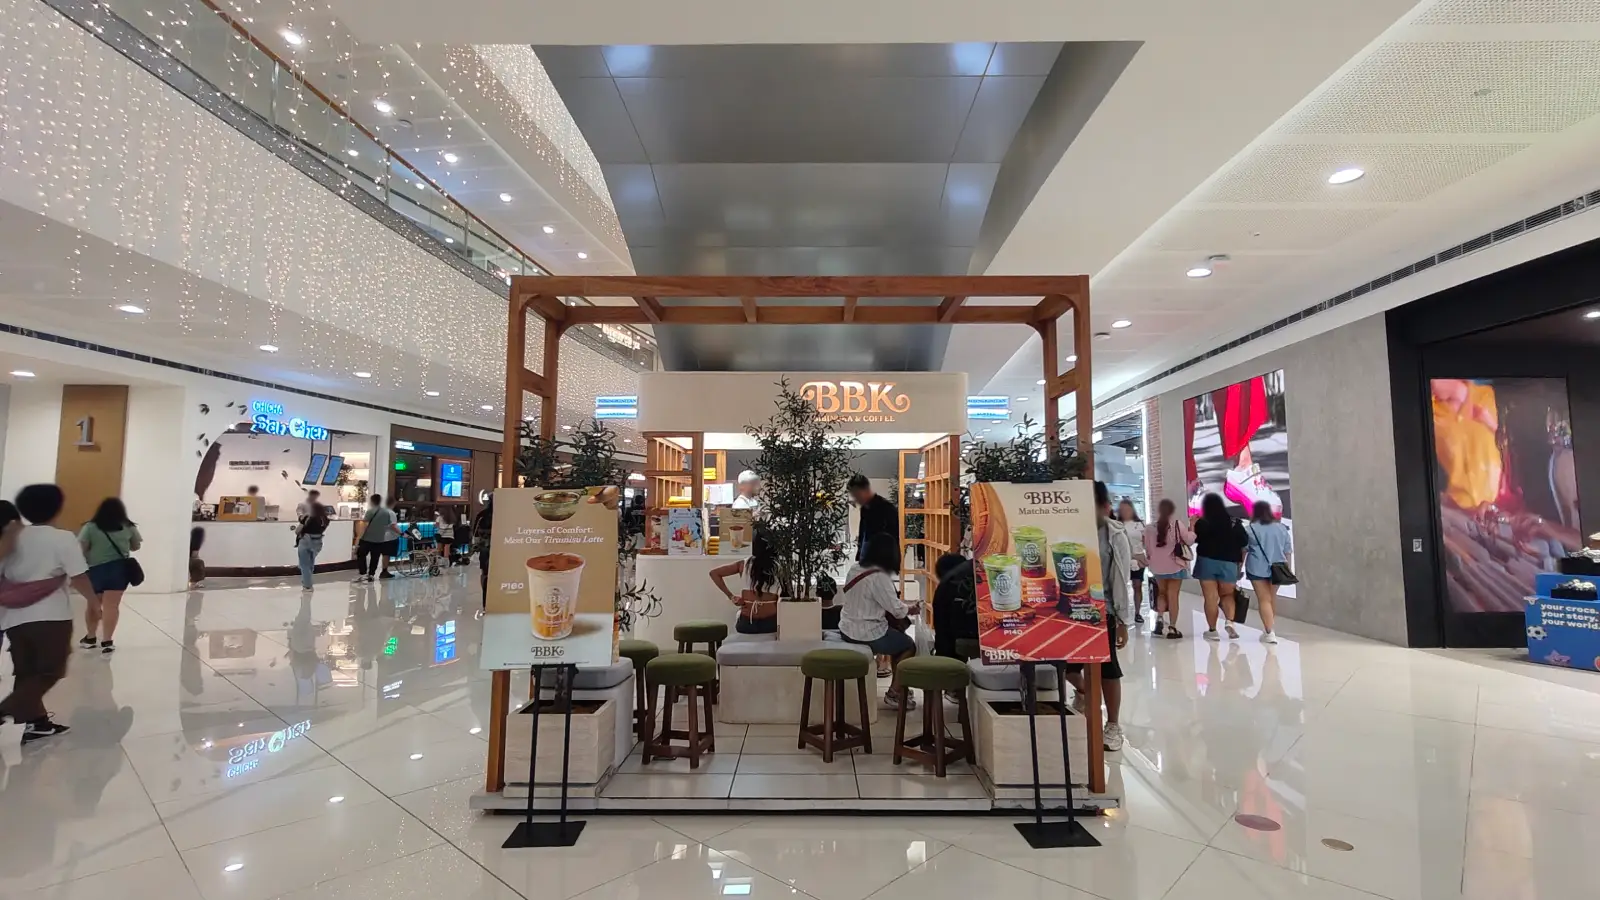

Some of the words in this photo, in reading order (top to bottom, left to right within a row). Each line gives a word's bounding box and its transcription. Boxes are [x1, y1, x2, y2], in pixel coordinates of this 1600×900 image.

[800, 381, 911, 413] BBK
[73, 415, 95, 446] 1
[1024, 491, 1071, 505] BBK
[1018, 507, 1050, 515] Matcha
[516, 527, 545, 535] Layers
[546, 526, 556, 534] of
[556, 526, 593, 534] Comfort:
[503, 536, 523, 544] Meet
[525, 536, 541, 544] Our
[544, 536, 581, 544] Tiramisu
[1565, 606, 1599, 614] crocs.
[1567, 613, 1598, 622] story.
[1567, 622, 1600, 630] world.
[531, 646, 564, 656] BBK
[984, 649, 1020, 660] BBK
